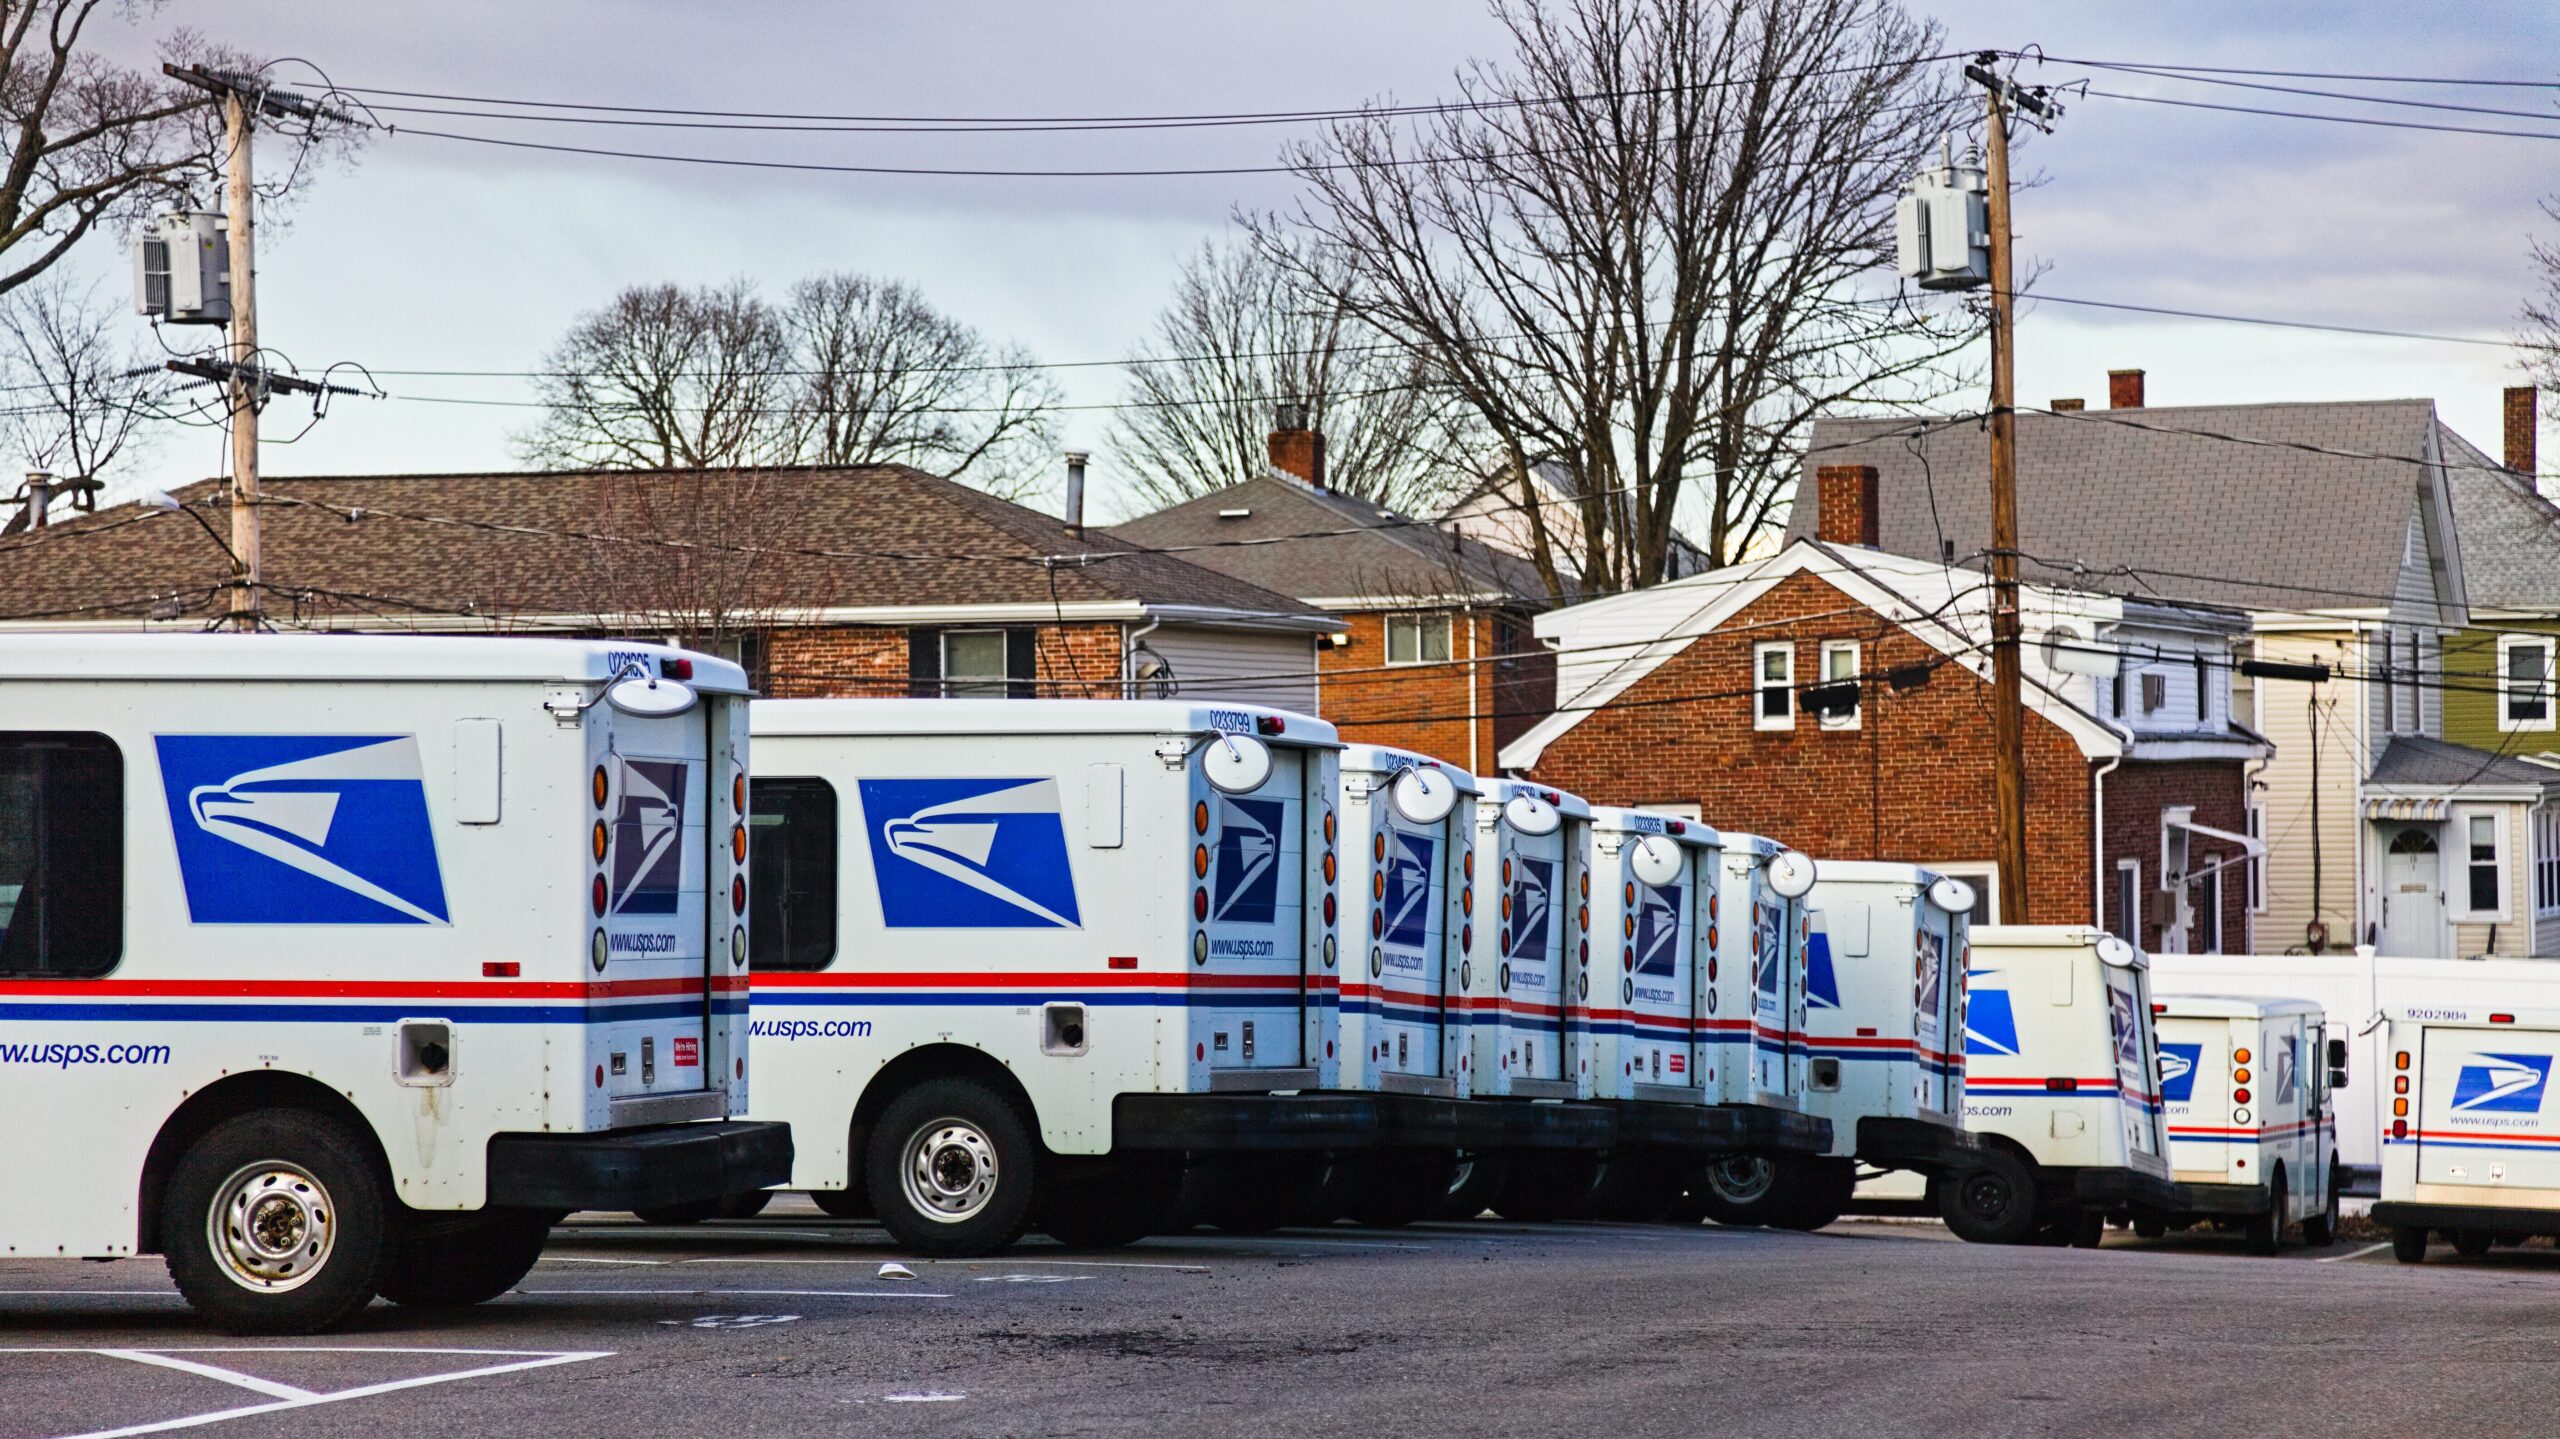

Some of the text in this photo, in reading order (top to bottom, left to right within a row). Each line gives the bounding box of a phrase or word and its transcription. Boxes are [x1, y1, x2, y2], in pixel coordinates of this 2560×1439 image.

[1210, 710, 1250, 733] 0233799
[1211, 939, 1274, 960] www.usps.com
[2407, 1008, 2467, 1020] 9202984
[0, 1044, 171, 1070] w.usps.com
[2450, 1116, 2539, 1128] www.usps.com
